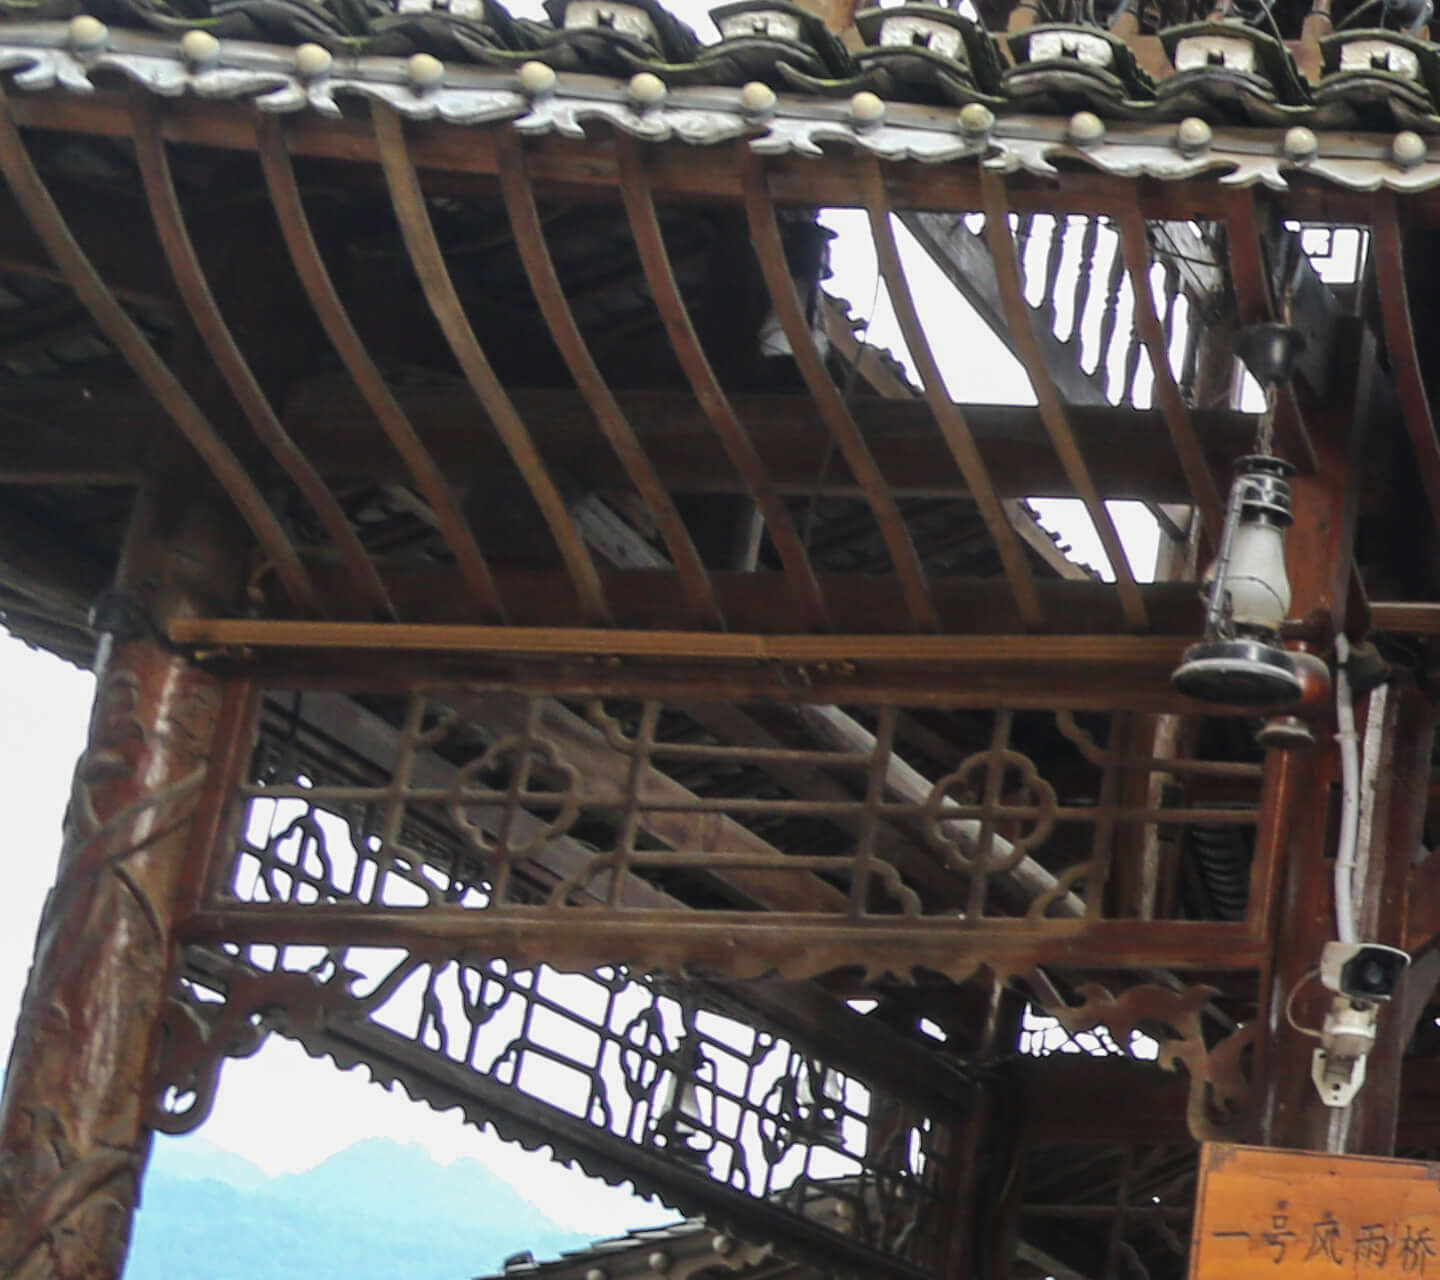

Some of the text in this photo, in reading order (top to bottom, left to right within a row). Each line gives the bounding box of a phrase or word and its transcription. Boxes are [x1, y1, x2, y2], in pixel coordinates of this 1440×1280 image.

[1212, 1209, 1438, 1276] 一号风雨桥
